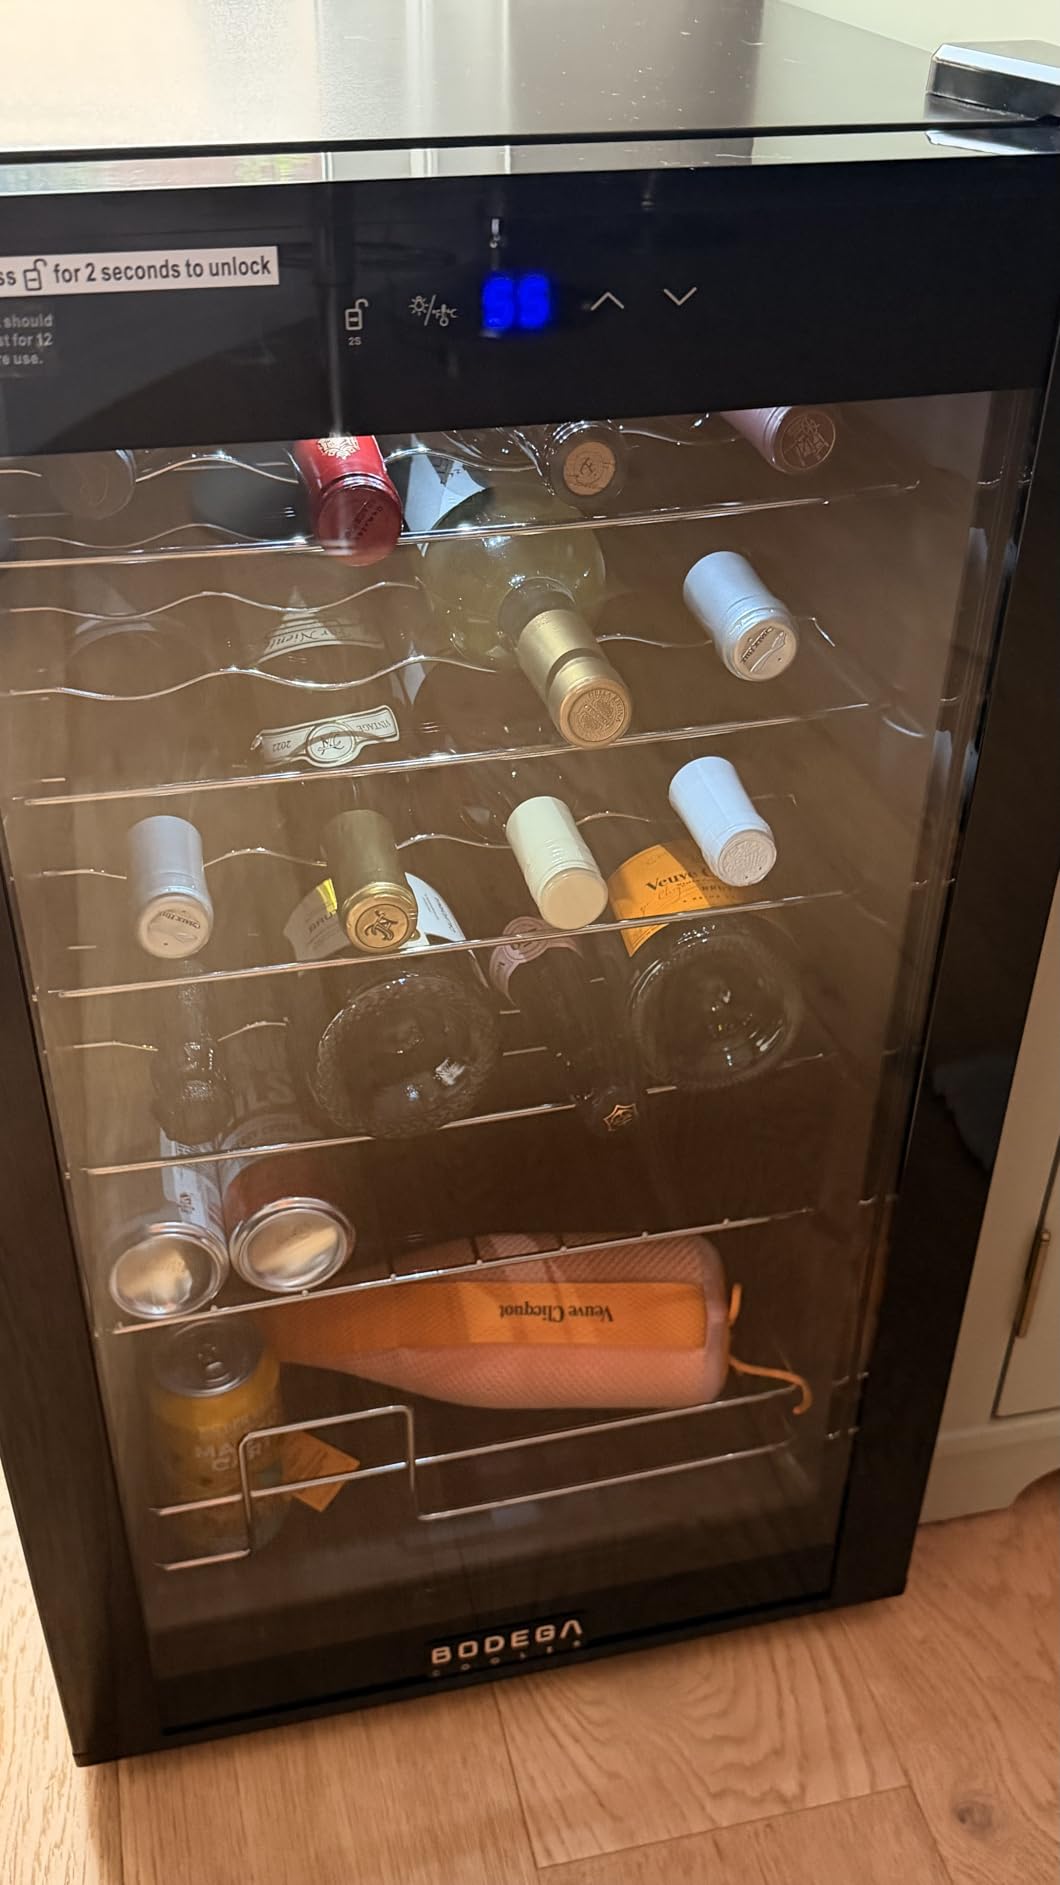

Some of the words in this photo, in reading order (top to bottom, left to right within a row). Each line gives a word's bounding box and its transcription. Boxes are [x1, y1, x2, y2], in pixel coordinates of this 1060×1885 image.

[53, 263, 81, 284] for
[85, 262, 97, 282] 2
[101, 259, 181, 281] seconds
[185, 258, 204, 278] to
[209, 255, 271, 277] unlock
[3, 312, 54, 329] should
[12, 332, 34, 347] for
[36, 331, 54, 347] 12
[13, 354, 44, 365] use.
[355, 719, 392, 732] VINTAGE
[272, 740, 292, 753] 2022
[646, 870, 698, 891] Veuve
[498, 1300, 565, 1323] Clicquot
[568, 1304, 615, 1323] Veuve
[431, 1620, 583, 1665] BODEGA
